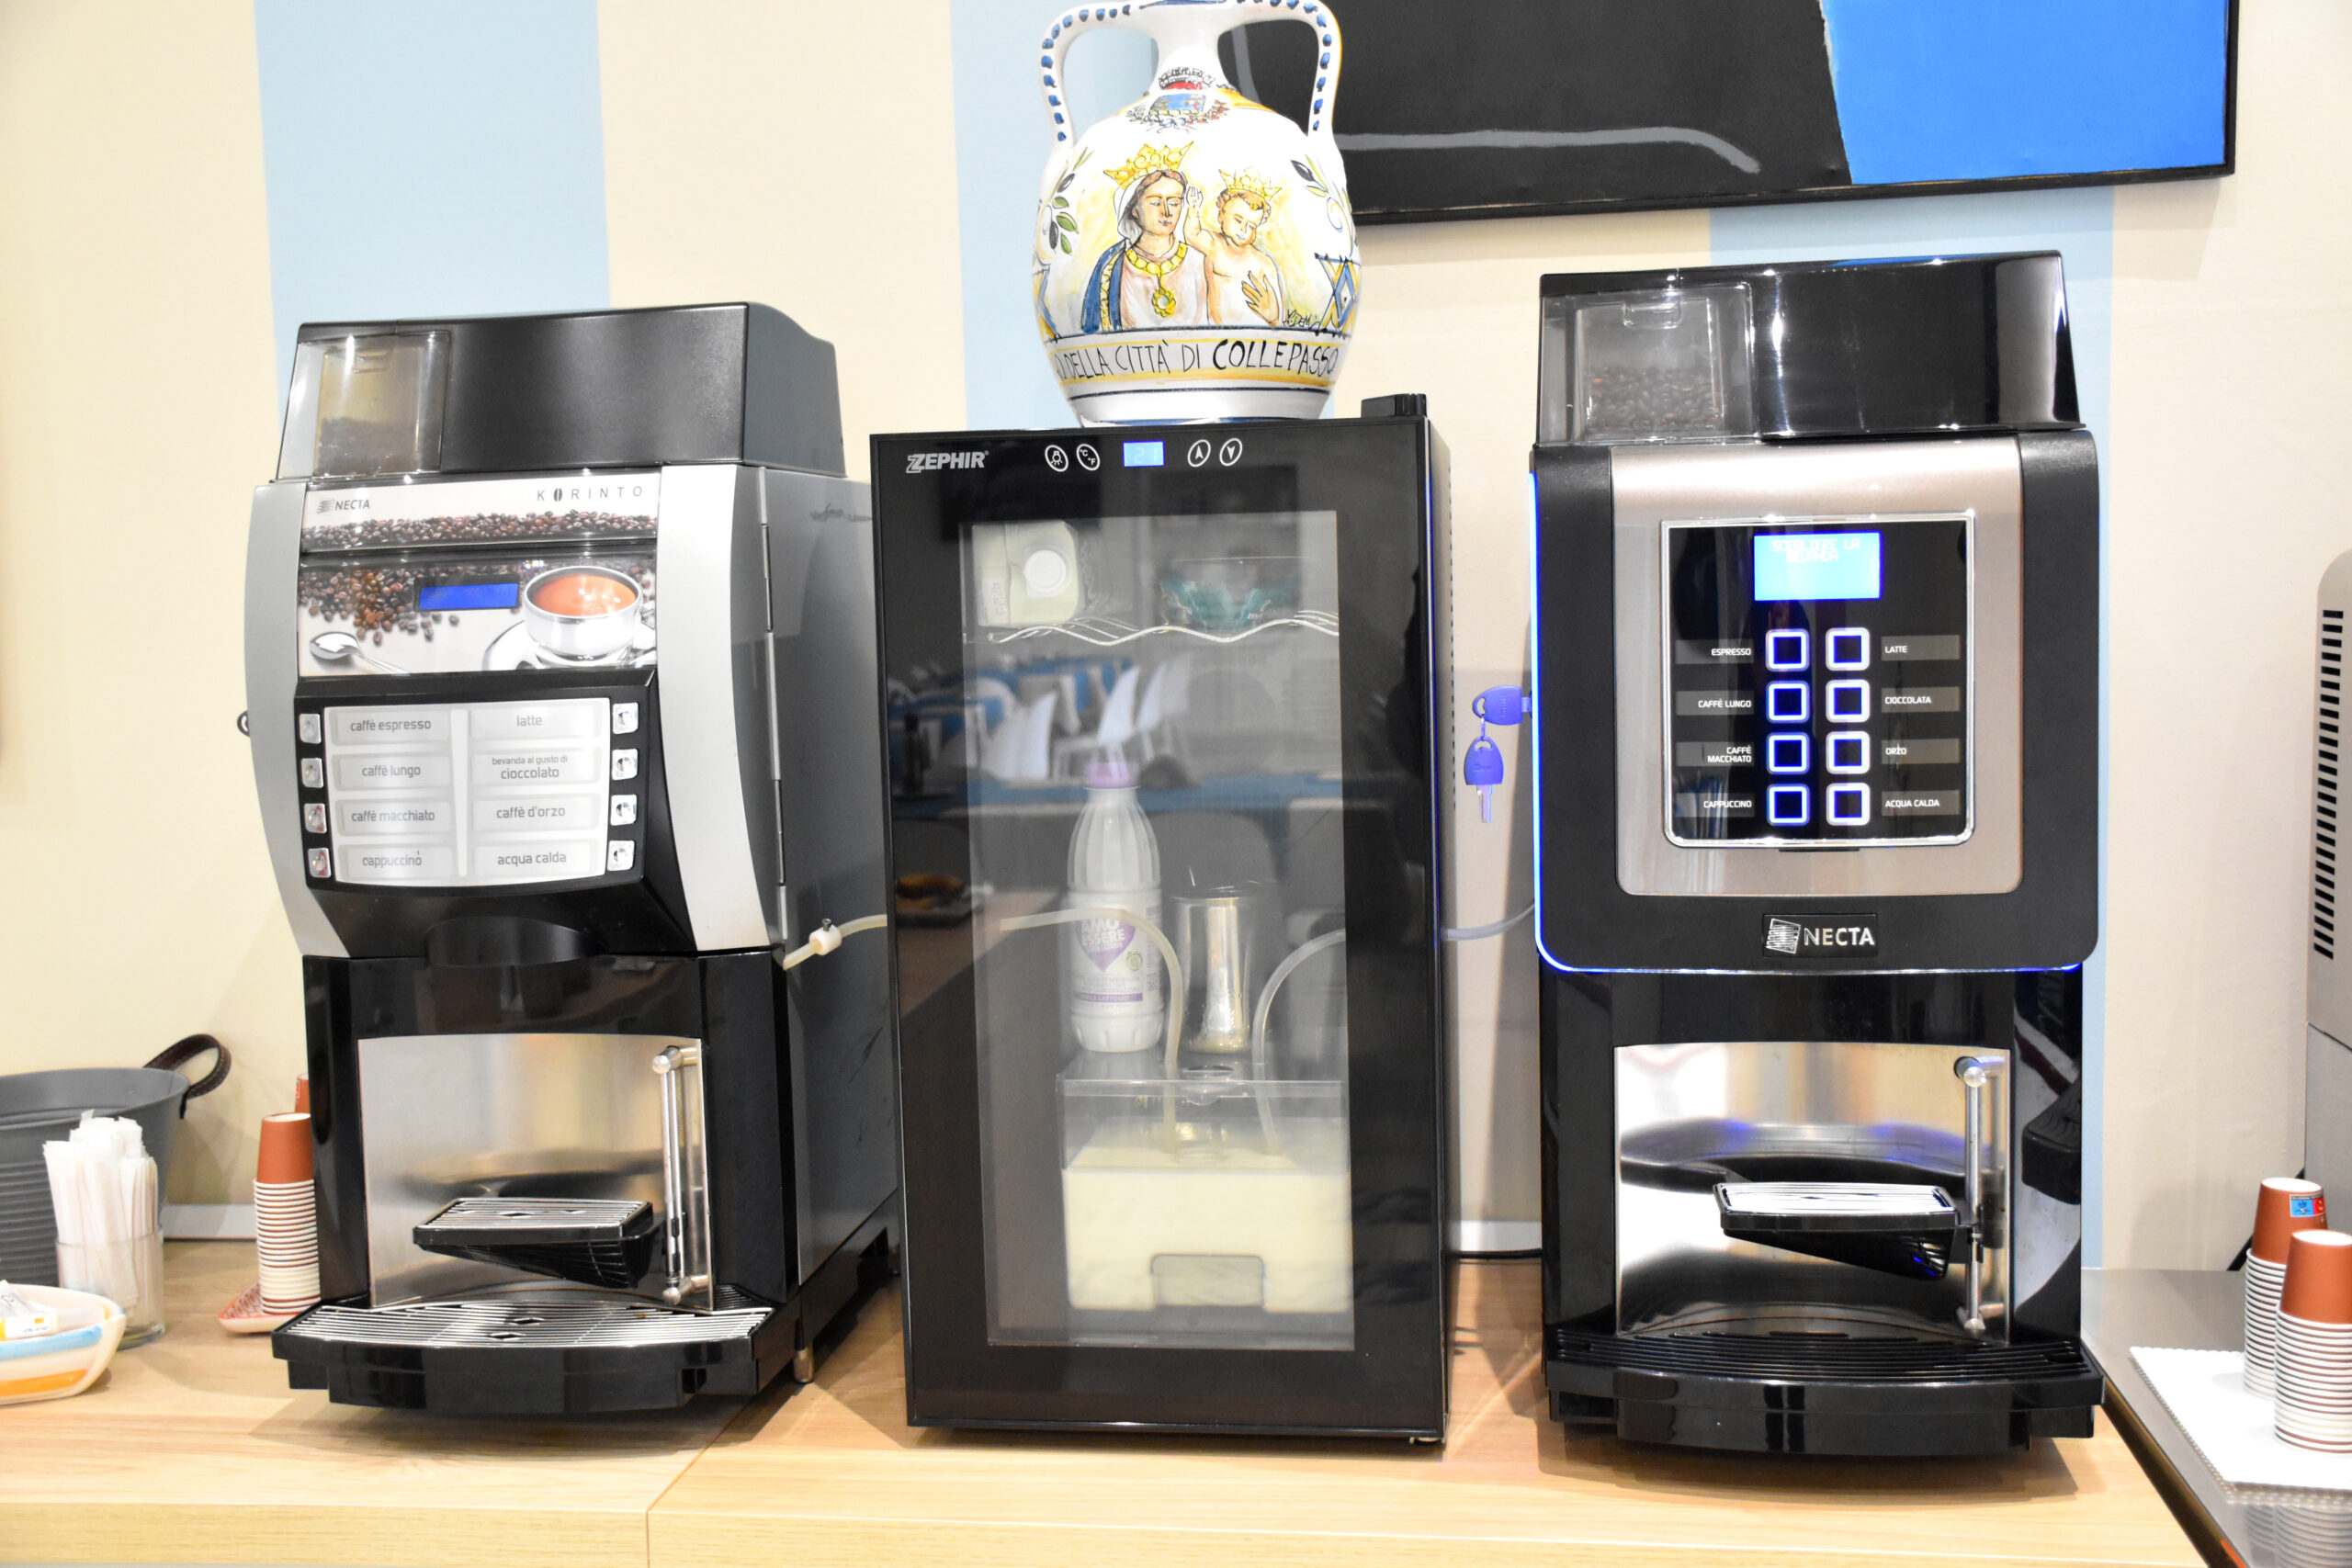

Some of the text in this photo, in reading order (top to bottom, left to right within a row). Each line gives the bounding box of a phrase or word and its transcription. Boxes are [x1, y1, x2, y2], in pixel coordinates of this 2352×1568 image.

[1064, 347, 1114, 380] DELLA
[1114, 339, 1170, 374] CITTÀ
[1182, 344, 1200, 373] DI
[1212, 339, 1339, 377] COLLEPASSO
[334, 499, 370, 511] NECTA
[1771, 537, 1860, 551] SCEGLIERE LA
[1711, 648, 1752, 657] ESPRESSO
[1884, 645, 1908, 654] LATTE
[1698, 697, 1752, 708] CAFFÈ LUNGO
[1884, 695, 1932, 705] CIOCCOLATA
[350, 718, 432, 734] caffè espresso
[516, 714, 542, 728] latte
[1726, 744, 1752, 755] CAFFÈ
[1884, 746, 1907, 756] ORZO
[492, 754, 568, 768] bevanda al gusto di
[1707, 754, 1752, 763] MACCHIATO
[362, 764, 422, 780] caffè lungo
[501, 766, 560, 780] cioccolato
[1703, 799, 1752, 809] CAPPUCCINO
[1884, 798, 1940, 809] ACQUA CALDA
[351, 808, 435, 822] caffè macchiato
[496, 805, 566, 819] caffè d'orzo
[497, 852, 567, 867] acqua calda
[1081, 928, 1125, 946] ESSERE
[1804, 927, 1875, 946] NECTA
